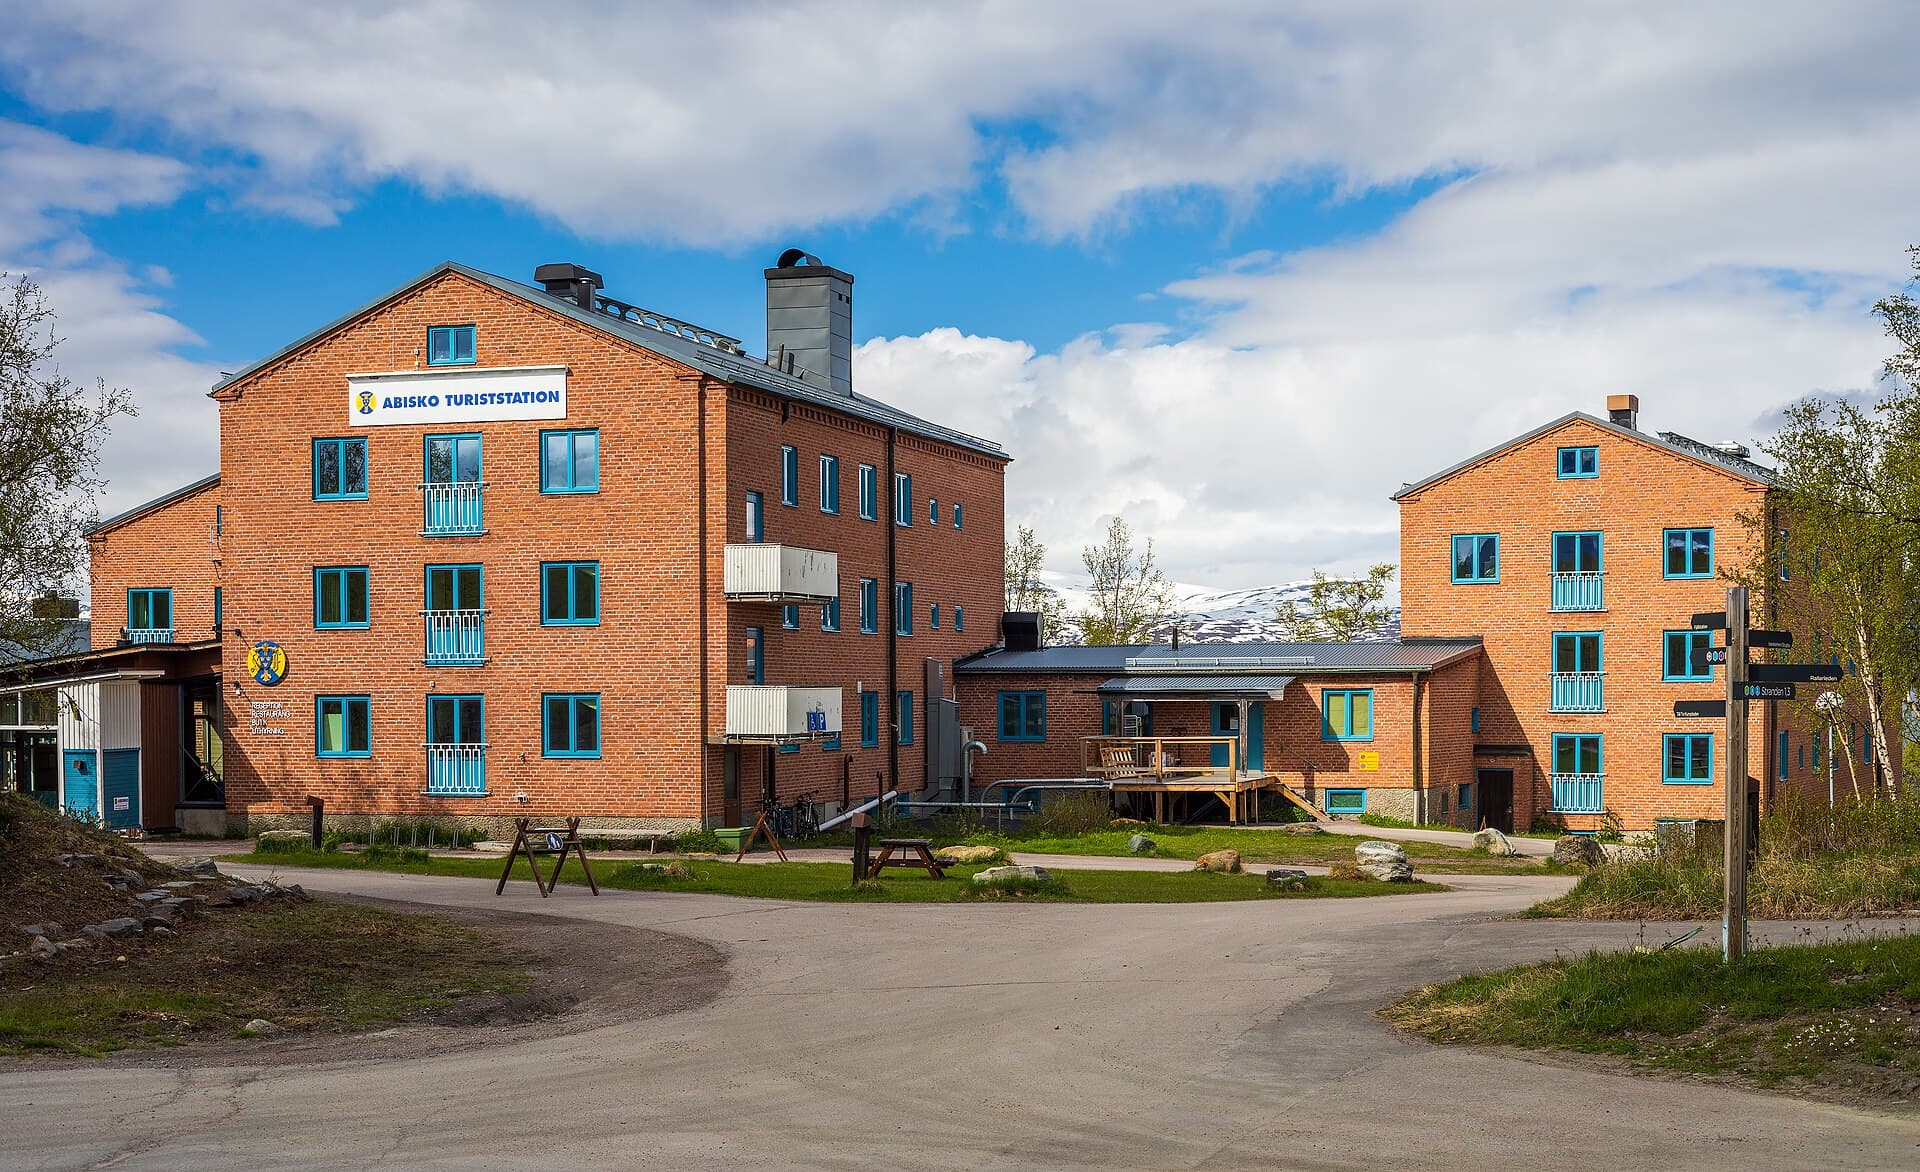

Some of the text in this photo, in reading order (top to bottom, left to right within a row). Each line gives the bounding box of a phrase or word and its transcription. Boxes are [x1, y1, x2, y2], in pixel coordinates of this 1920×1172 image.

[382, 390, 560, 409] ABISKO TURISTSTATION
[1761, 685, 1784, 696] Stranden
[251, 702, 283, 710] RECEPTION
[819, 713, 825, 729] P
